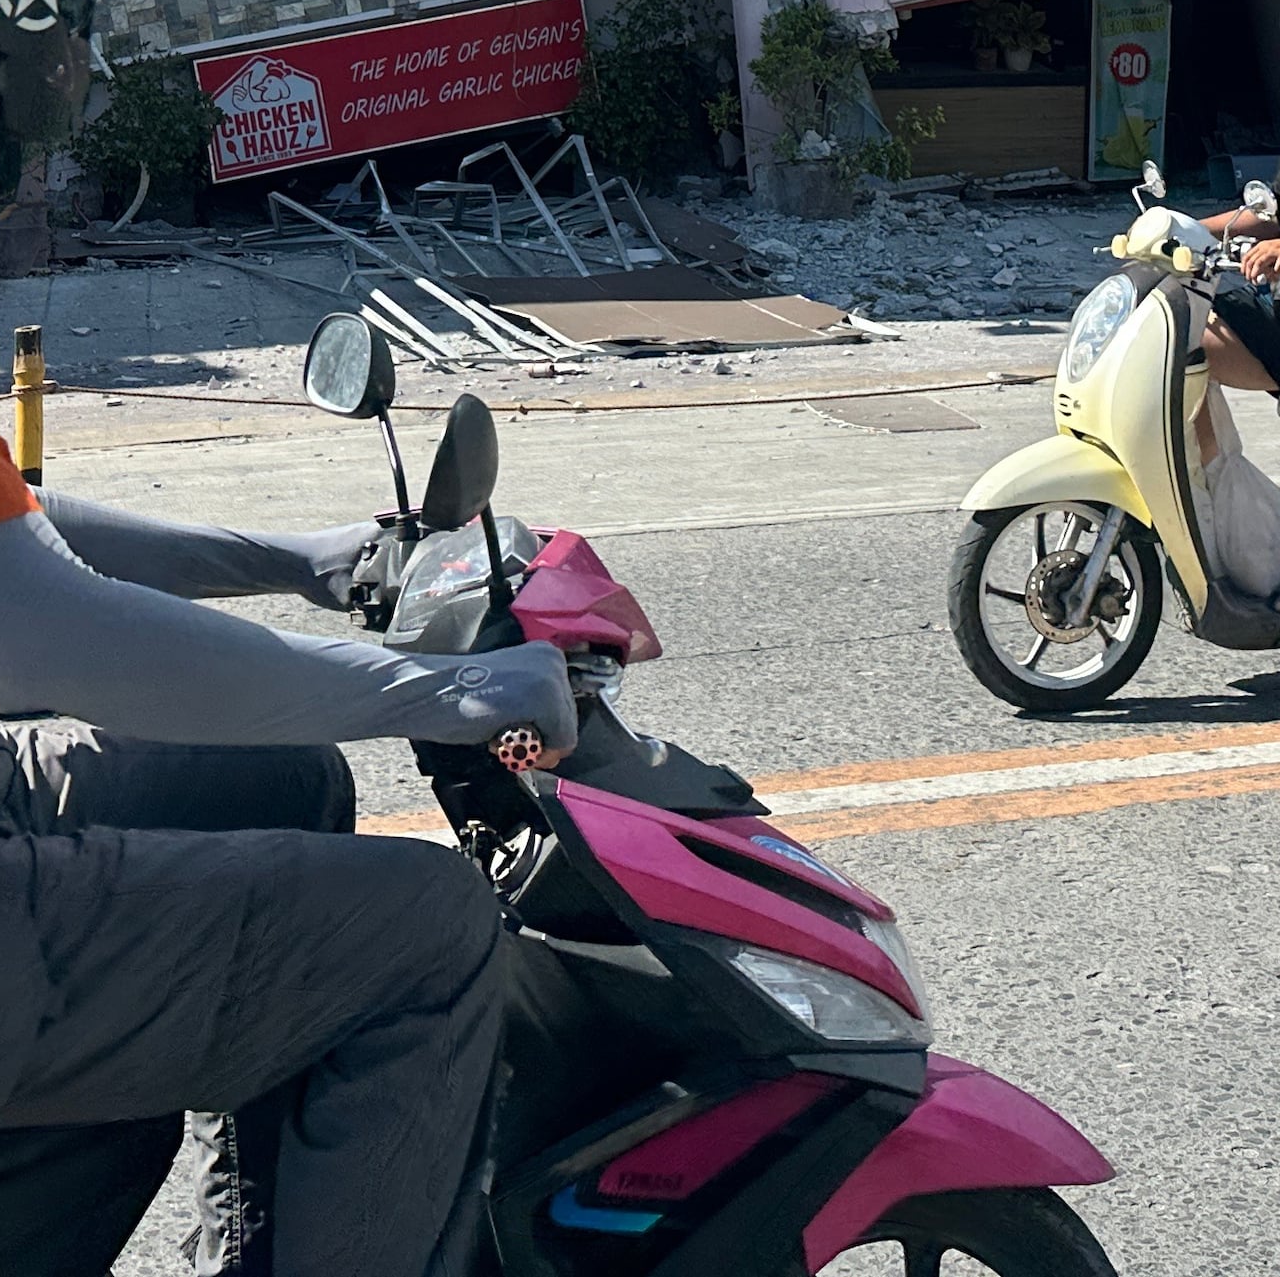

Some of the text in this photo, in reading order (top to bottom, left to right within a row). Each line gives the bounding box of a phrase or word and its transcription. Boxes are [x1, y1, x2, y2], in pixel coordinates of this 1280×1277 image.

[350, 19, 582, 84] THE HOME OF GENSAN'S
[220, 99, 316, 138] CHICKEN
[341, 88, 429, 123] ORIGINAL
[438, 72, 503, 104] GARLIC
[242, 126, 302, 158] HAUZ
